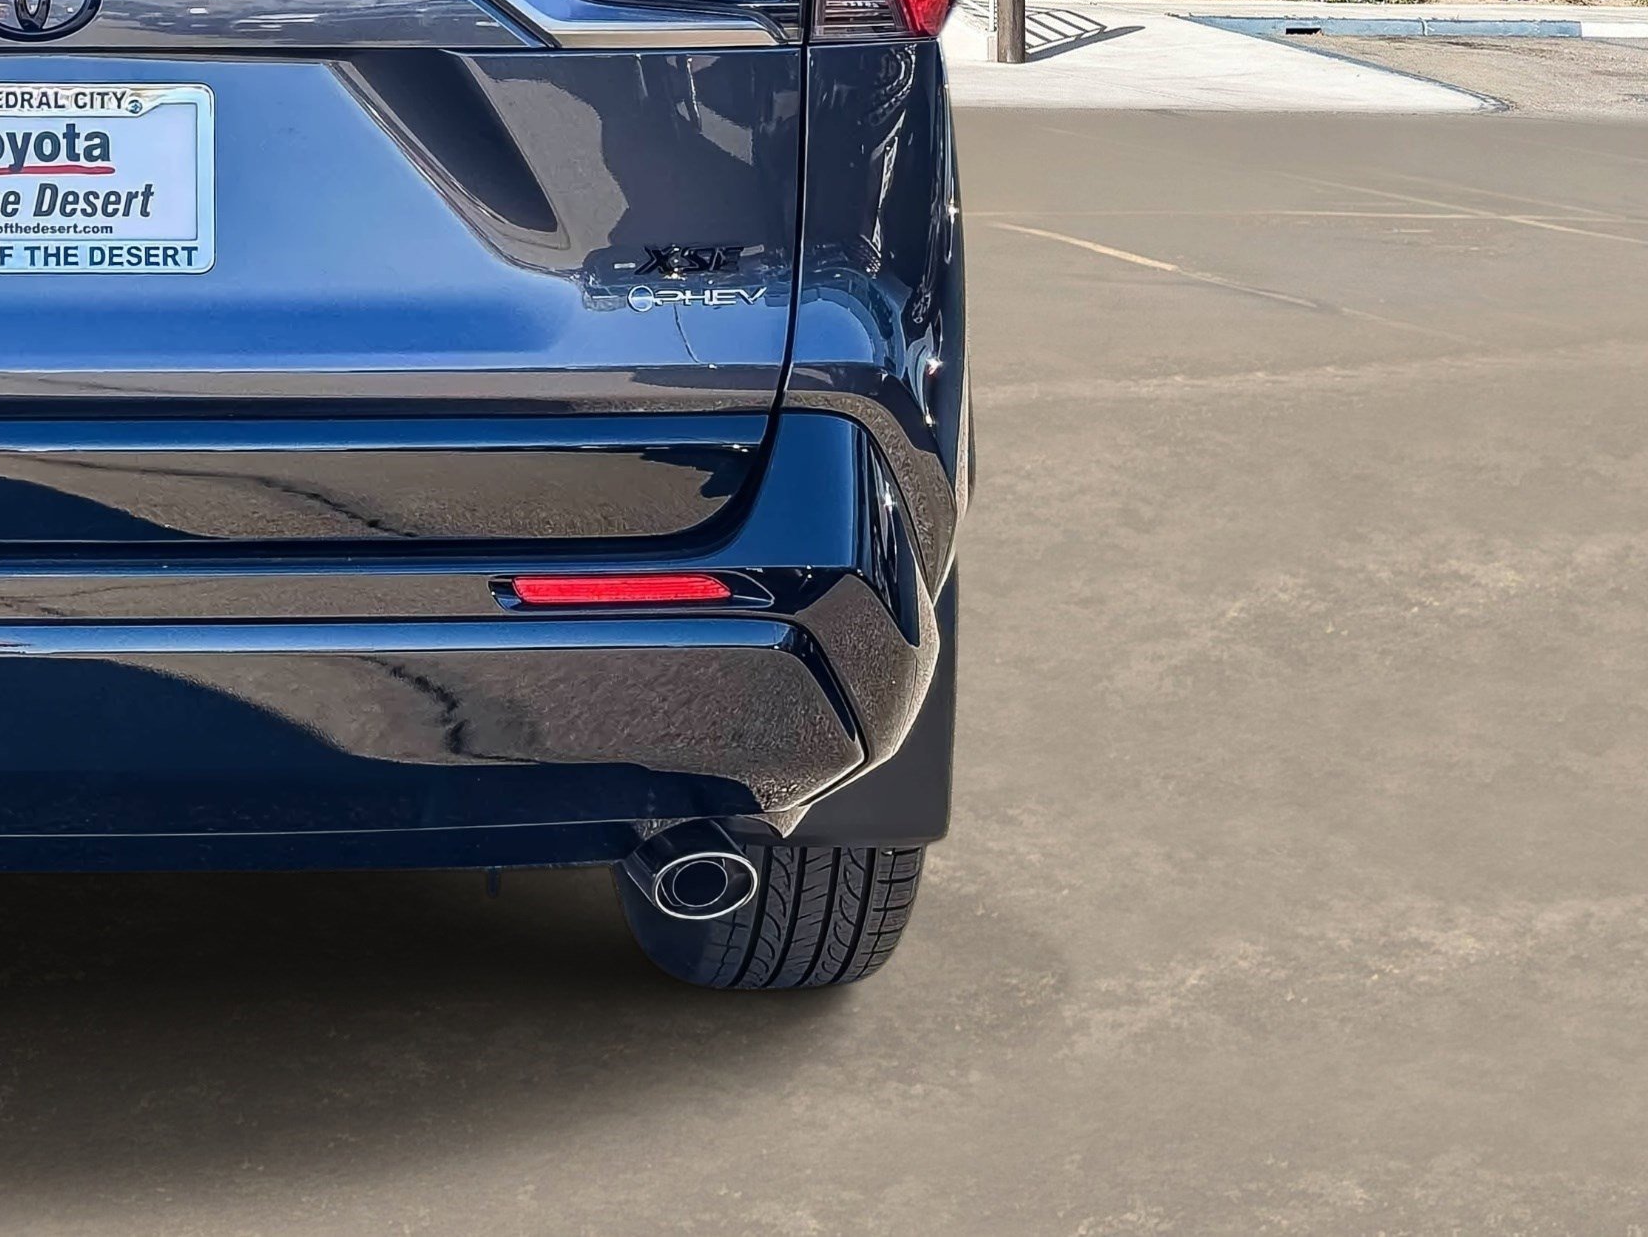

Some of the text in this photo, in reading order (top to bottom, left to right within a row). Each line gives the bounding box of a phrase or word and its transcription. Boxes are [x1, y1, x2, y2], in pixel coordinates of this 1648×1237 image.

[73, 89, 128, 111] CITY
[33, 183, 155, 218] Desert
[23, 245, 80, 268] THE
[87, 245, 200, 268] DESERT
